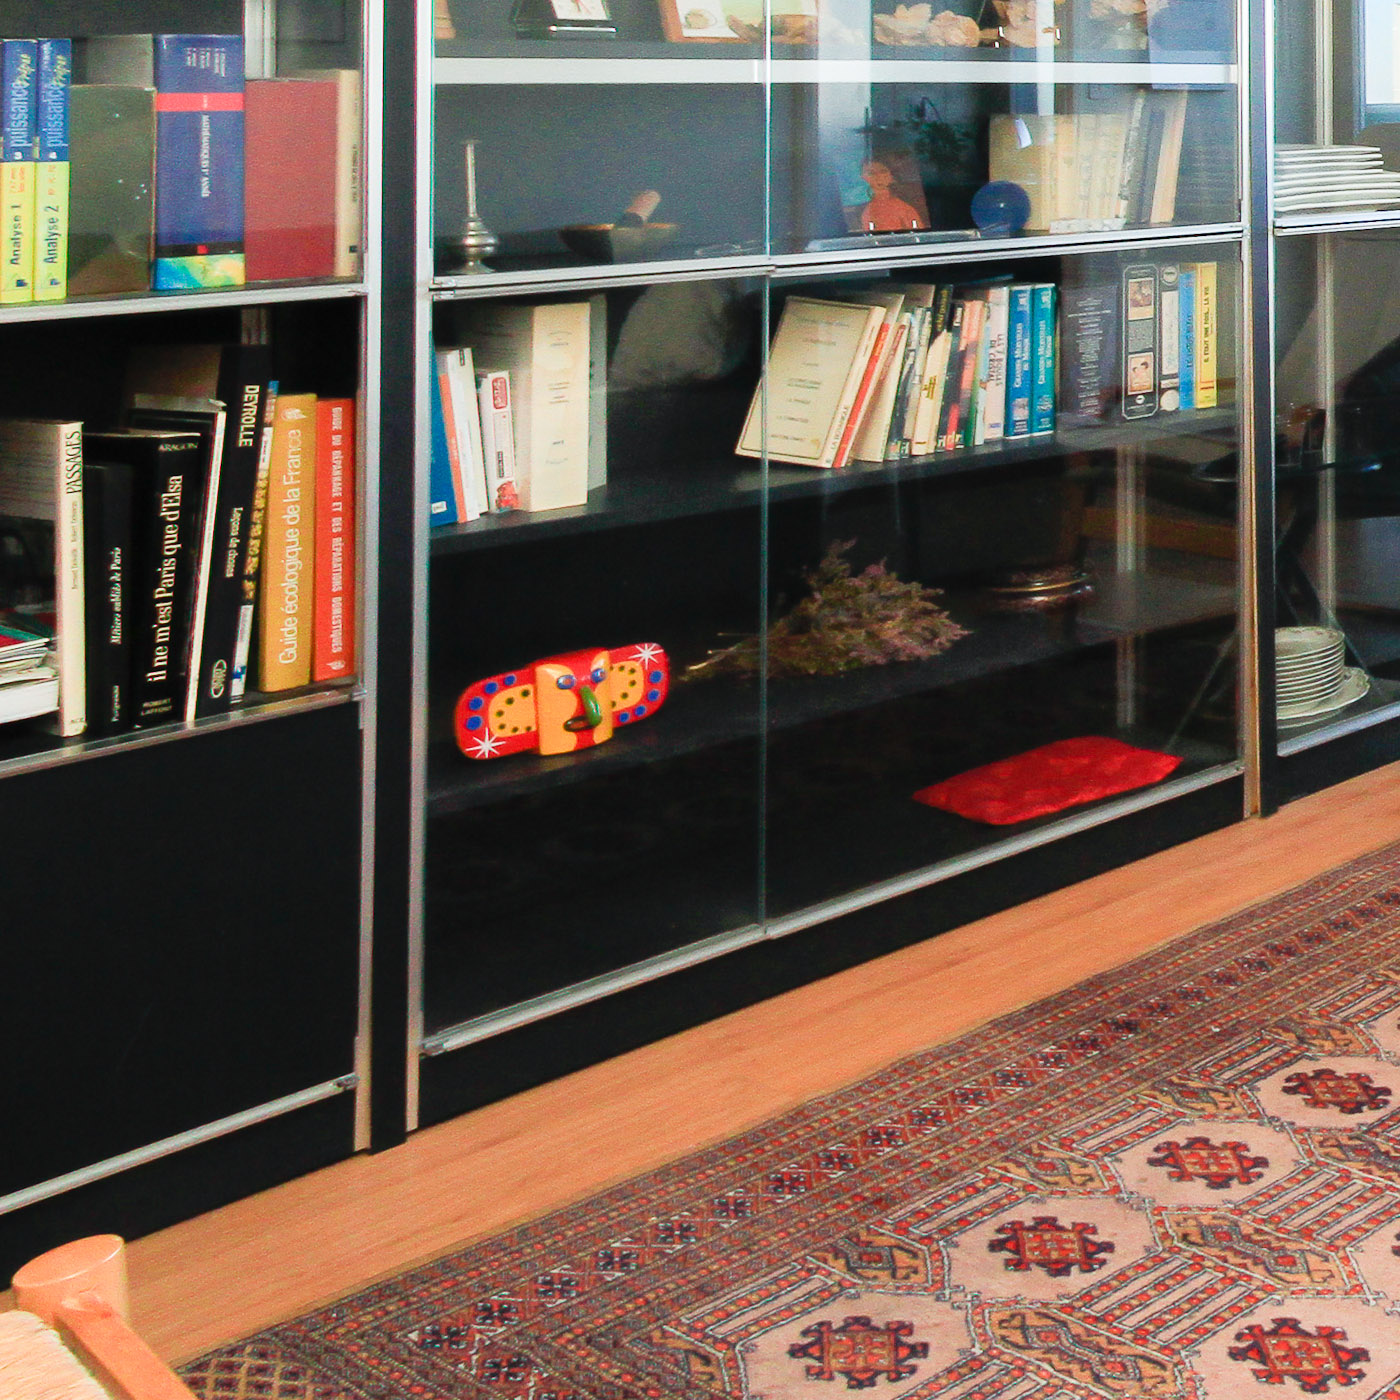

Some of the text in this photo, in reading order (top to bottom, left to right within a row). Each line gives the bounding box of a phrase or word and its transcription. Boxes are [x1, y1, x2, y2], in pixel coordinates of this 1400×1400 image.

[44, 205, 59, 213] 2
[9, 215, 23, 266] Analyse
[43, 216, 61, 264] Analyse
[238, 385, 260, 448] DEYROLLE
[65, 429, 82, 495] PASSAGES
[331, 501, 343, 512] ET
[331, 516, 343, 533] DES
[229, 537, 241, 548] de
[278, 429, 303, 665] Guide écologique de la France
[109, 546, 122, 571] Paris
[225, 549, 239, 577] choses
[109, 571, 121, 582] de
[146, 474, 183, 683] il ne m'est Paris que d'Elsa
[110, 613, 122, 645] Métiers
